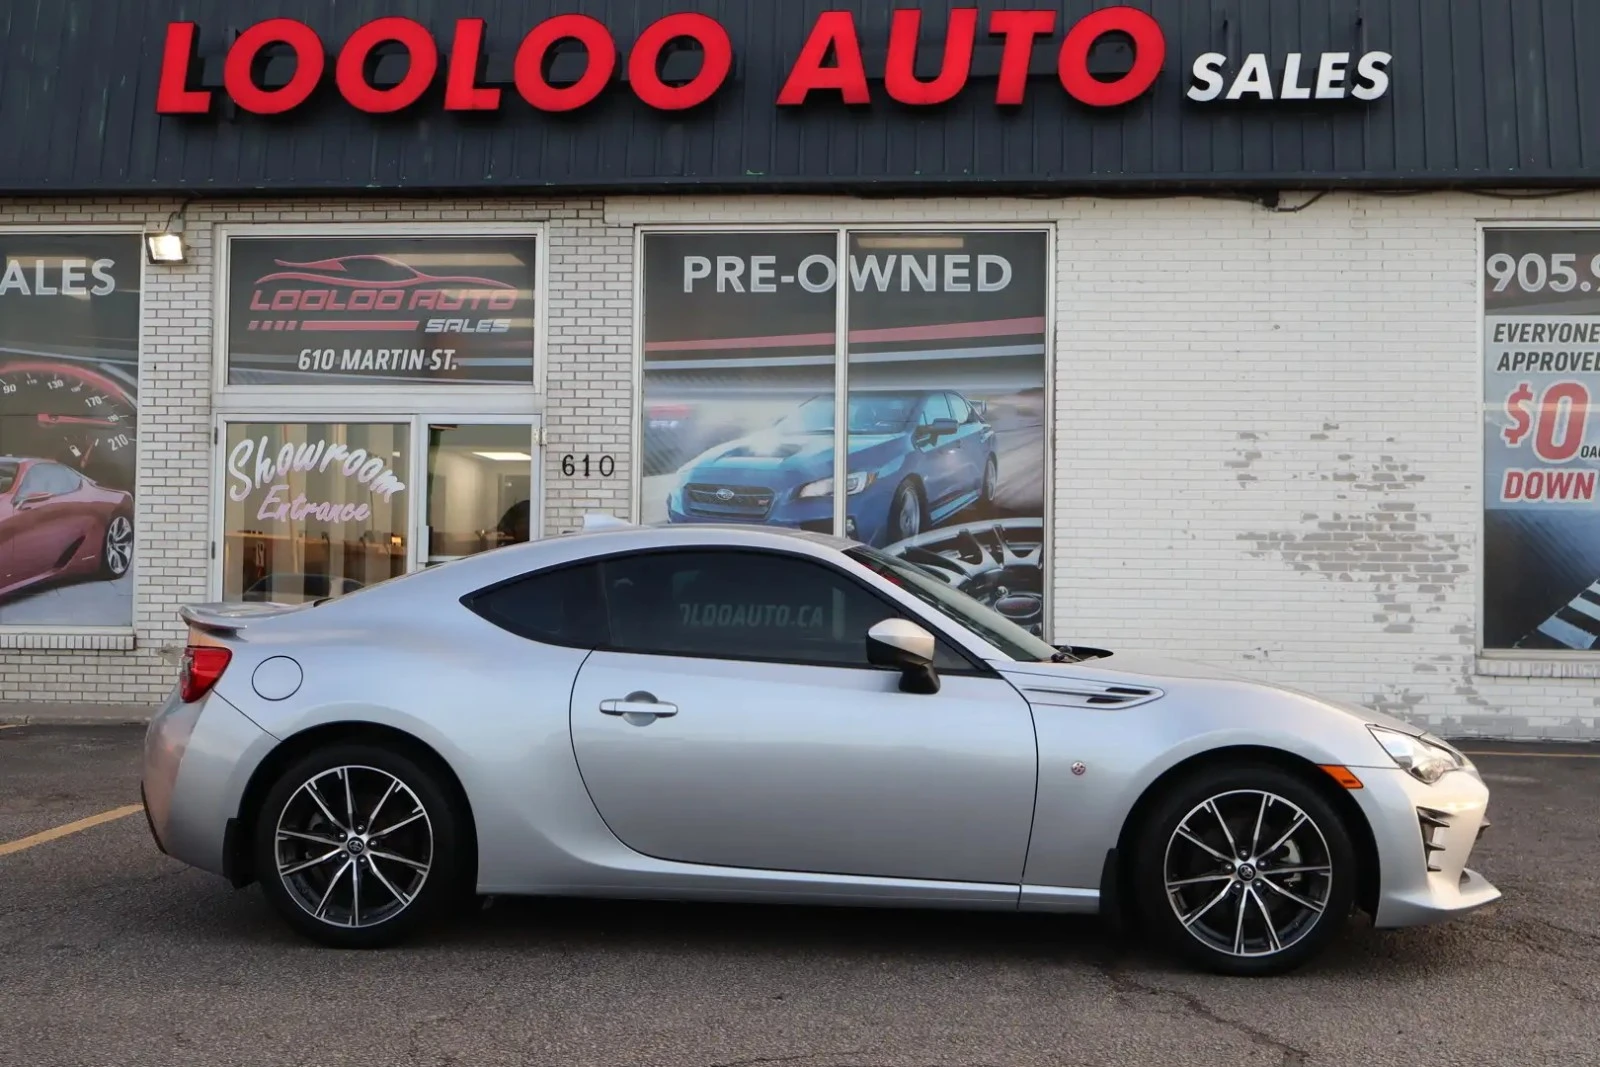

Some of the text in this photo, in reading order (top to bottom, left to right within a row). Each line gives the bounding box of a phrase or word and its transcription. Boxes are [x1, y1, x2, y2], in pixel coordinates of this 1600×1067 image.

[156, 6, 1393, 115] LOOLOO AUTO SALES
[683, 254, 1013, 294] PRE-OWNED
[250, 289, 518, 311] LOOLOO AUTO
[424, 318, 511, 333] SALES
[1493, 323, 1600, 343] EVERYONE
[298, 348, 458, 371] 610 MARTIN ST.
[3, 383, 17, 394] 90
[47, 379, 64, 390] 130
[85, 396, 102, 407] 170
[1503, 382, 1589, 461] $0
[108, 434, 128, 451] 210
[1580, 445, 1600, 458] OA
[228, 435, 406, 504] Showroom
[562, 454, 615, 477] 610
[1503, 471, 1595, 500] DOWN
[256, 484, 371, 524] Entrance
